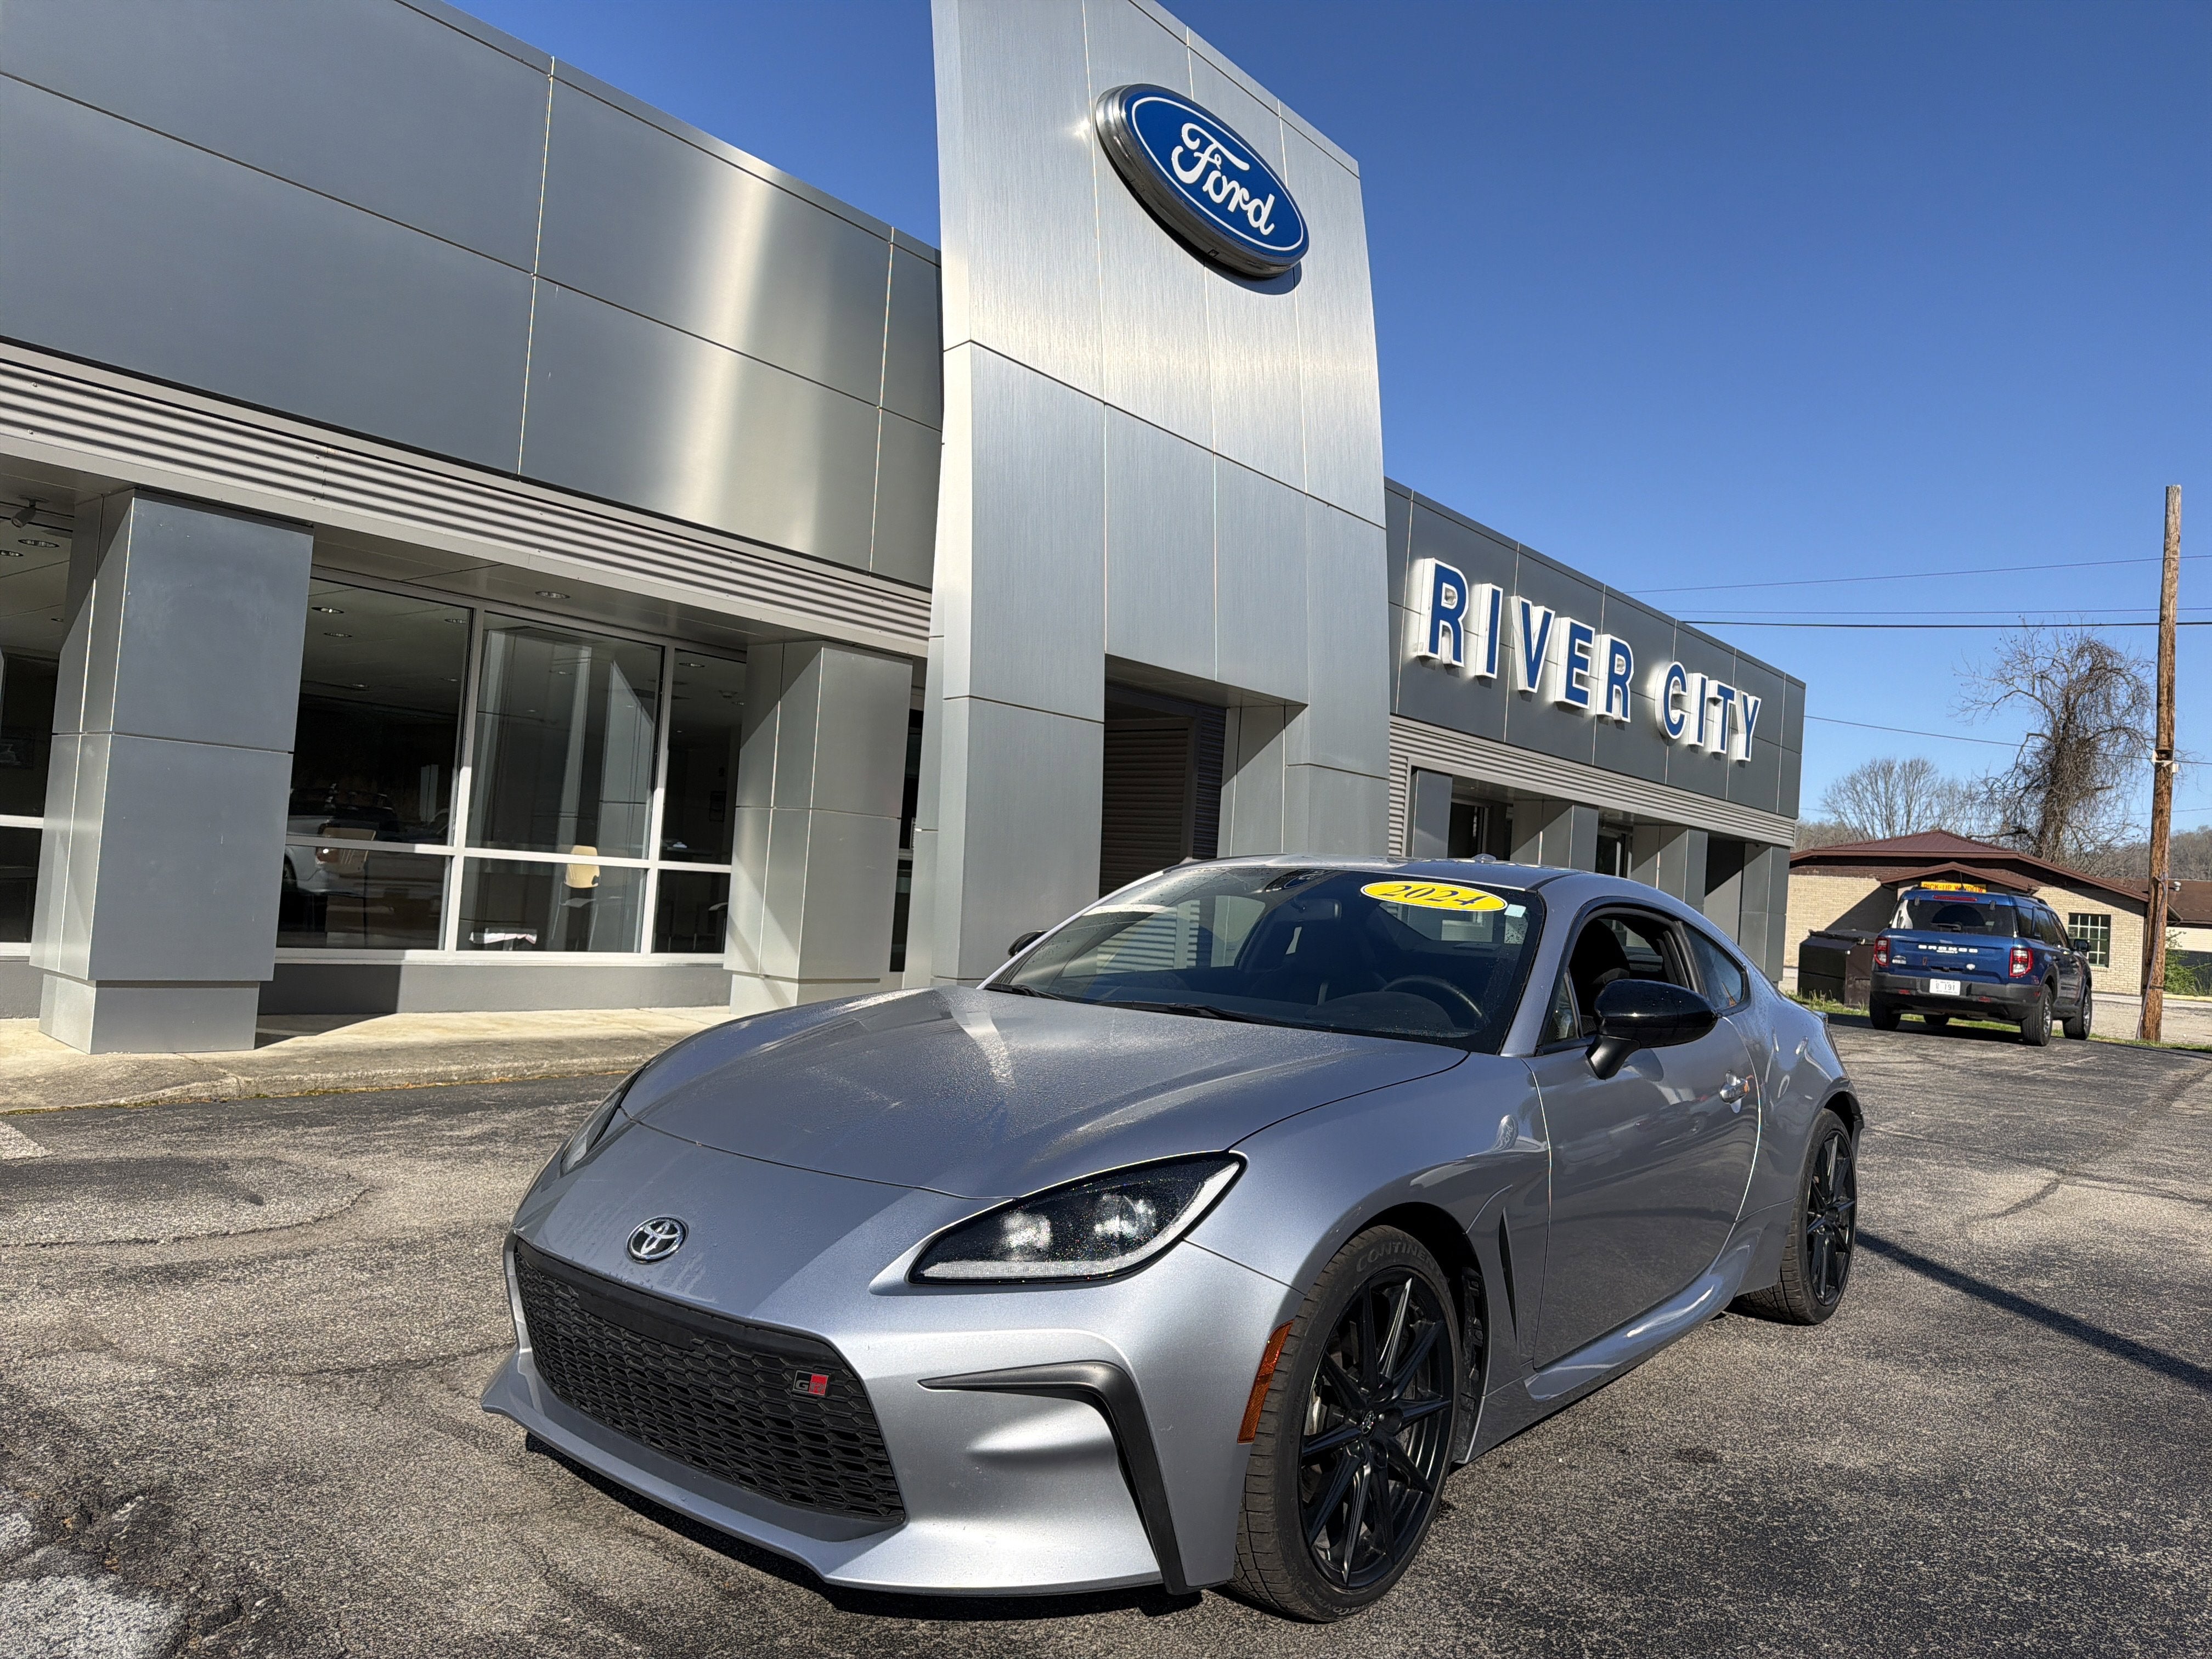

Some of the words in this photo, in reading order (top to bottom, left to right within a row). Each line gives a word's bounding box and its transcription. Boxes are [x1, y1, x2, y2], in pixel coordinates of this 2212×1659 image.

[1172, 123, 1274, 235] Ford
[1417, 557, 1634, 723] RIVER
[1655, 662, 1761, 761] CITY
[1378, 885, 1488, 906] 2024
[795, 1379, 825, 1394] GR
